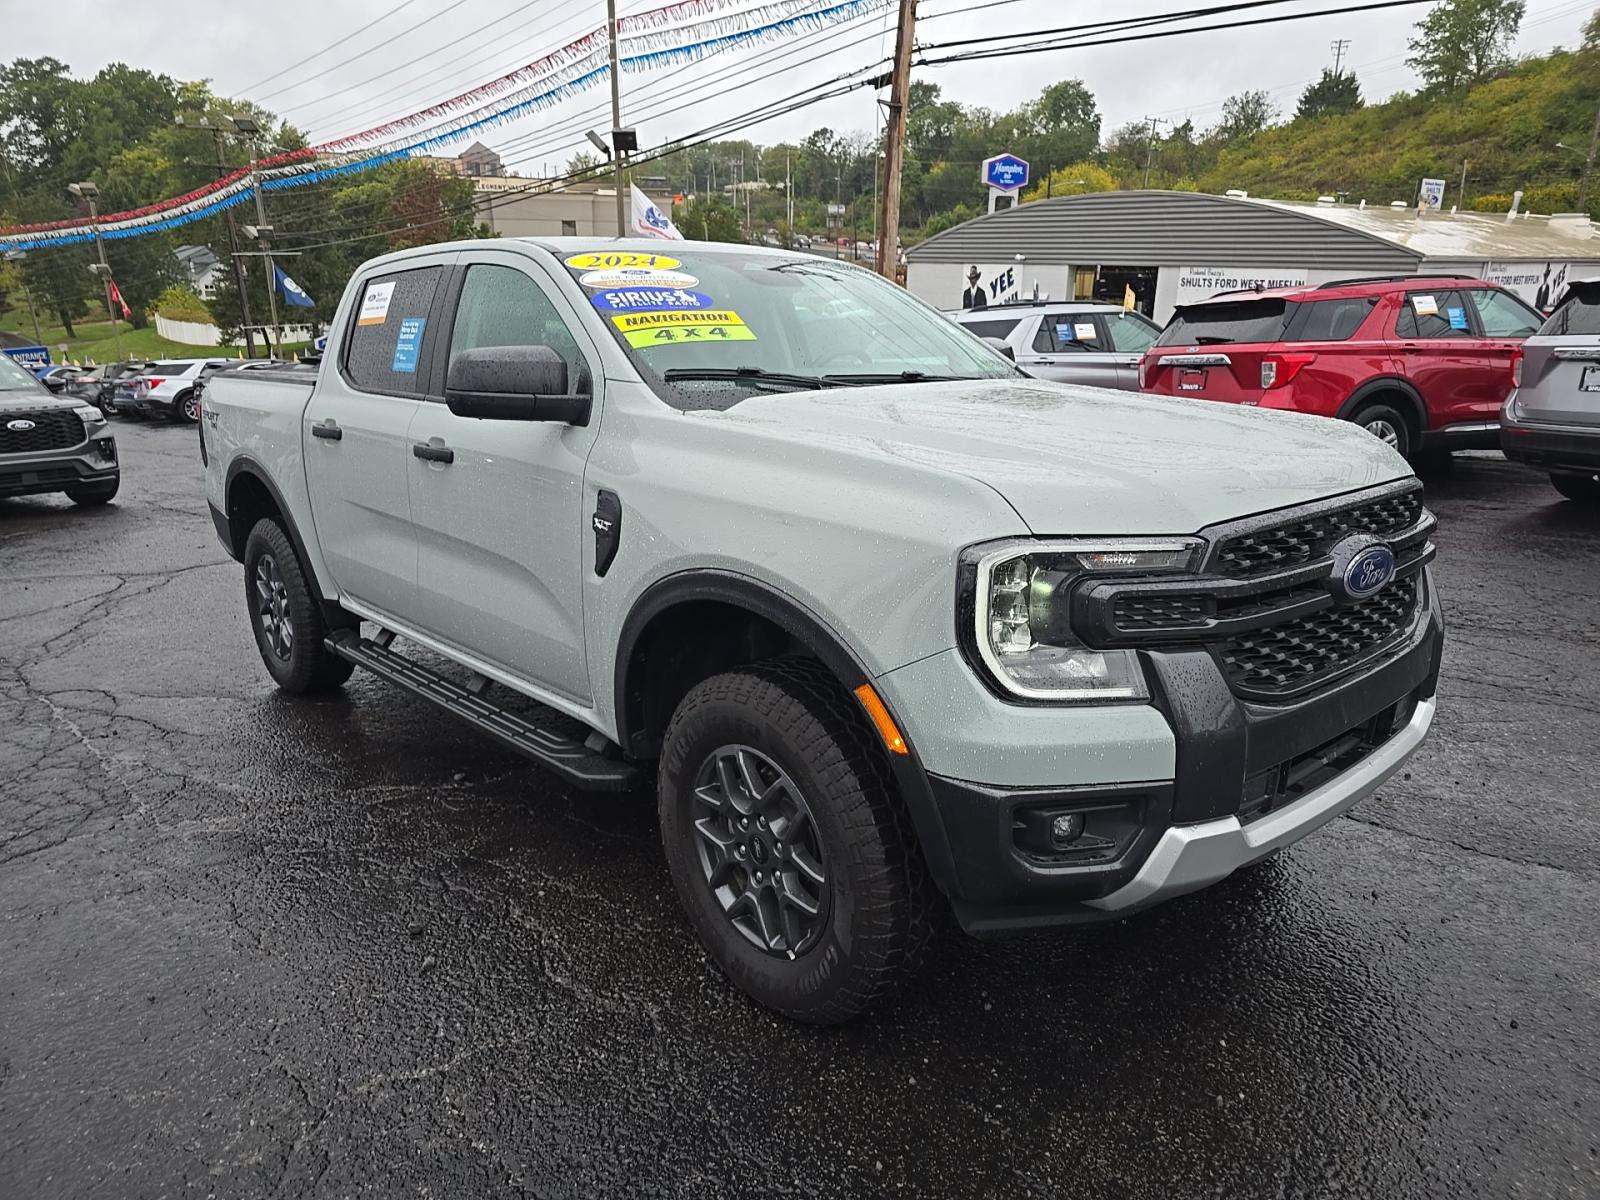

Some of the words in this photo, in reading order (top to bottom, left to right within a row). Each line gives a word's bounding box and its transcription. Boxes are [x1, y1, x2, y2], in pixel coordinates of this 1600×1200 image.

[992, 162, 1024, 176] Hampton
[587, 256, 657, 267] 2024
[990, 267, 1014, 299] YEE
[1181, 277, 1212, 288] SHULTS
[1215, 279, 1238, 289] FORD
[605, 290, 675, 306] SIRIUS
[626, 314, 730, 325] NAVIGATION
[1360, 557, 1386, 588] Ford
